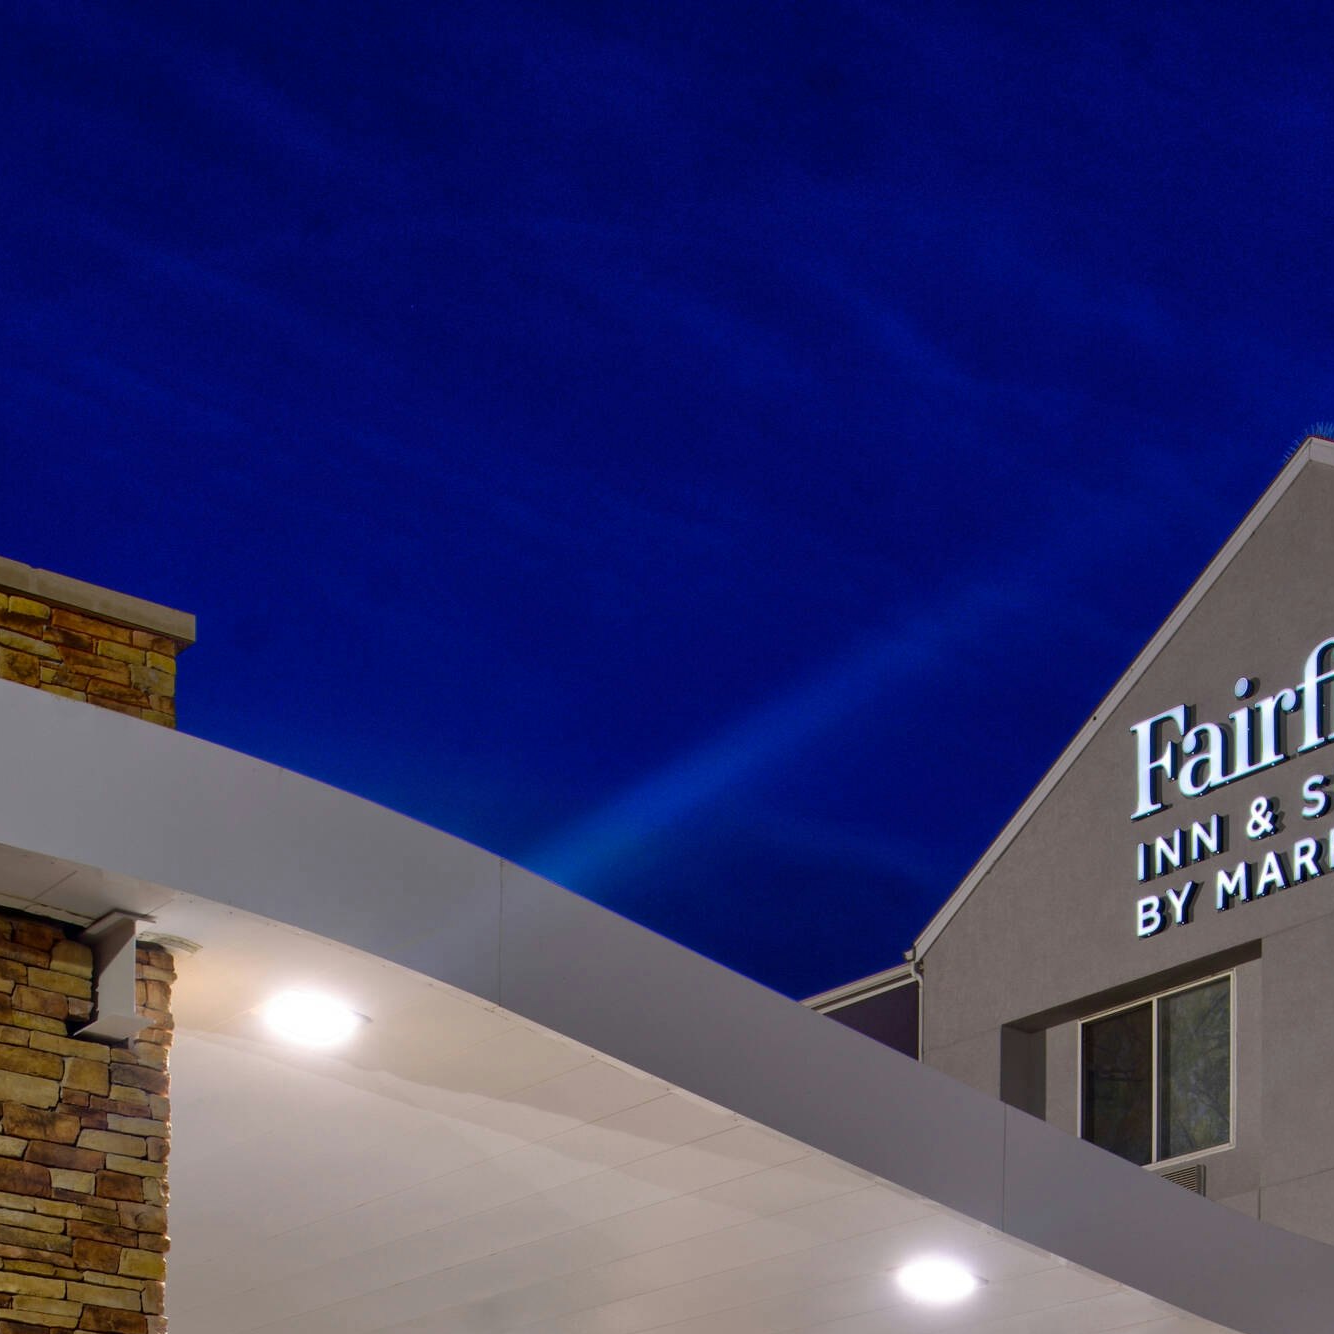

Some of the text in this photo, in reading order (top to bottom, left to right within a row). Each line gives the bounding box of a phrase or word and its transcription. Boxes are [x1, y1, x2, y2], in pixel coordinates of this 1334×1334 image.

[1137, 813, 1224, 883] INN
[1246, 795, 1278, 840] &
[1136, 880, 1196, 938] BY
